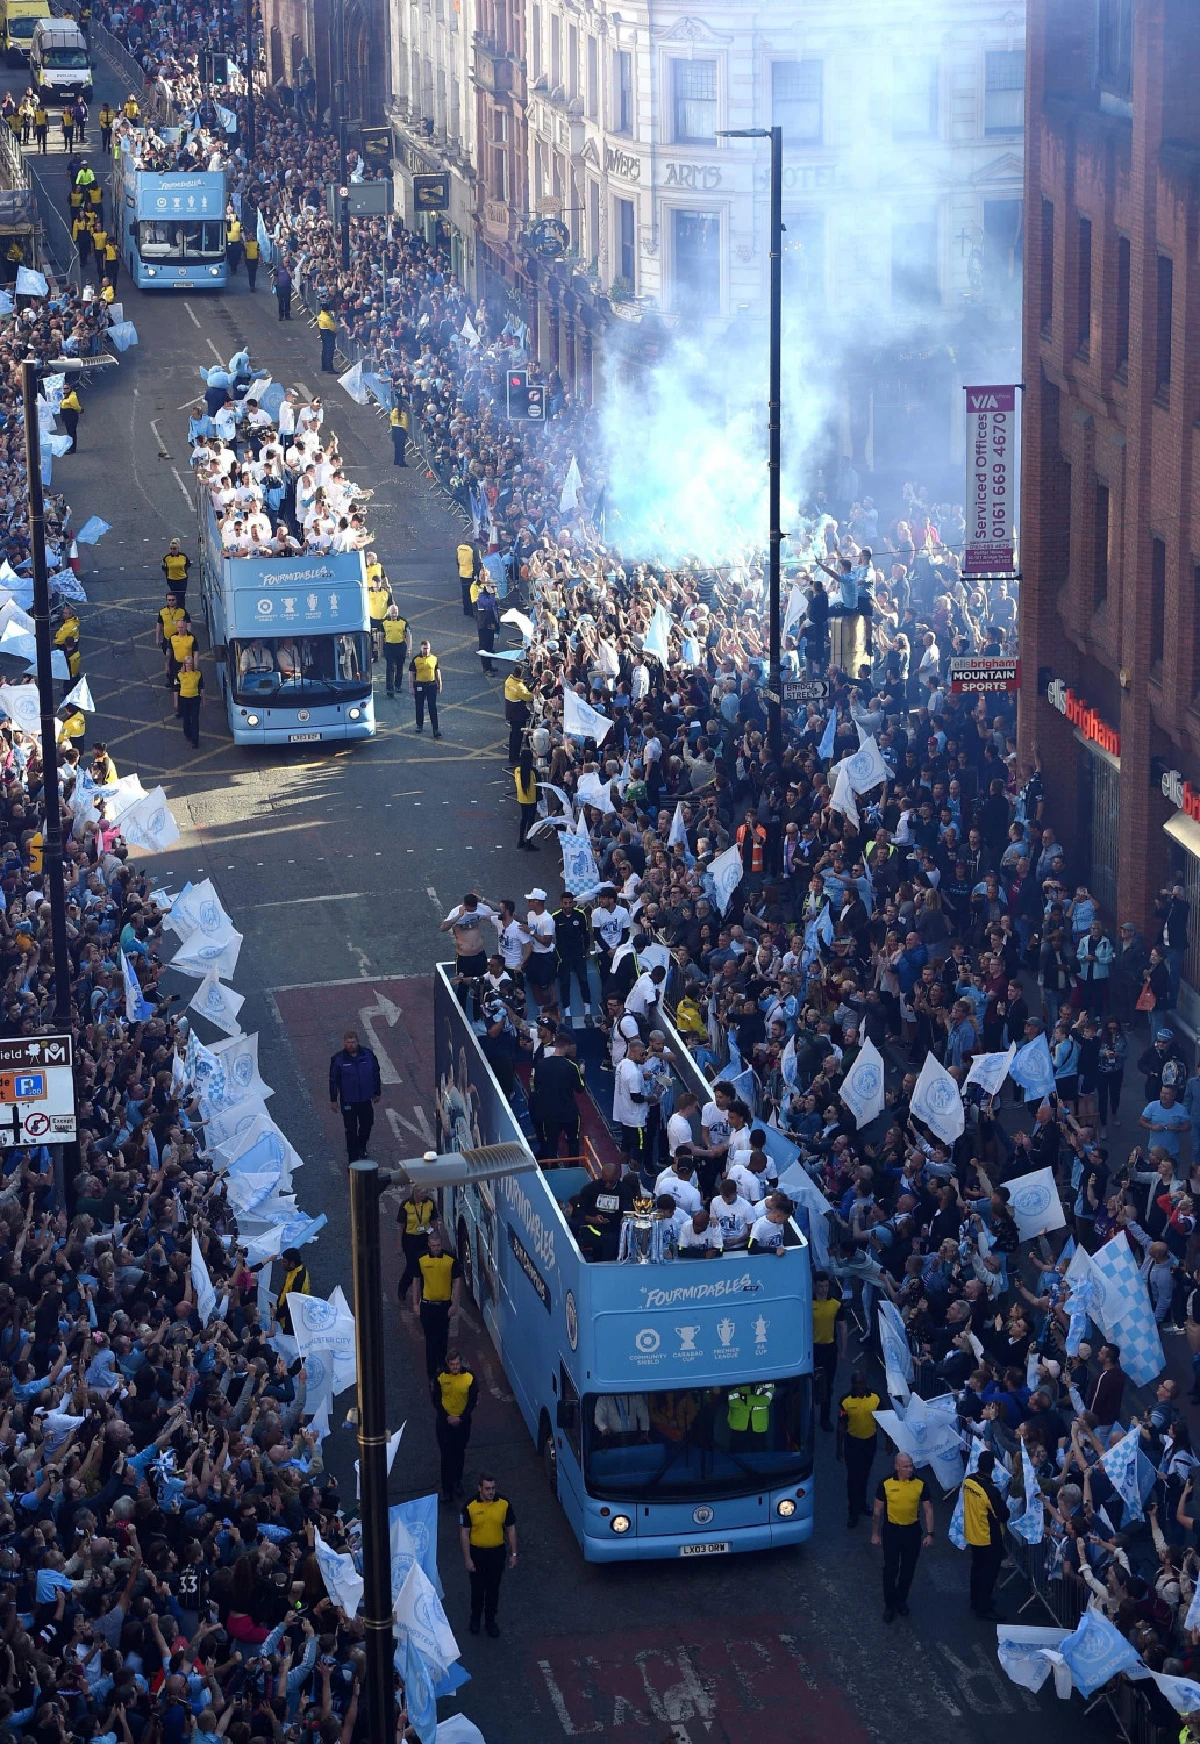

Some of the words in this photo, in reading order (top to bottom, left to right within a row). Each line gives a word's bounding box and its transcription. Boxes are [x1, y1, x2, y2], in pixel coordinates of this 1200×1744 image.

[664, 163, 722, 188] ARMS
[971, 395, 998, 408] VIA
[975, 413, 988, 468] Offices
[992, 412, 1007, 458] 4670
[992, 463, 1007, 496] 669
[975, 473, 988, 539] Serviced
[992, 501, 1007, 539] 0161
[953, 670, 1015, 680] MOUNTAIN
[962, 681, 1007, 692] SPORTS
[647, 1274, 752, 1308] FOURMIDABLES
[335, 1337, 351, 1345] CITY
[683, 1544, 706, 1554] LX03
[179, 1576, 198, 1594] 33
